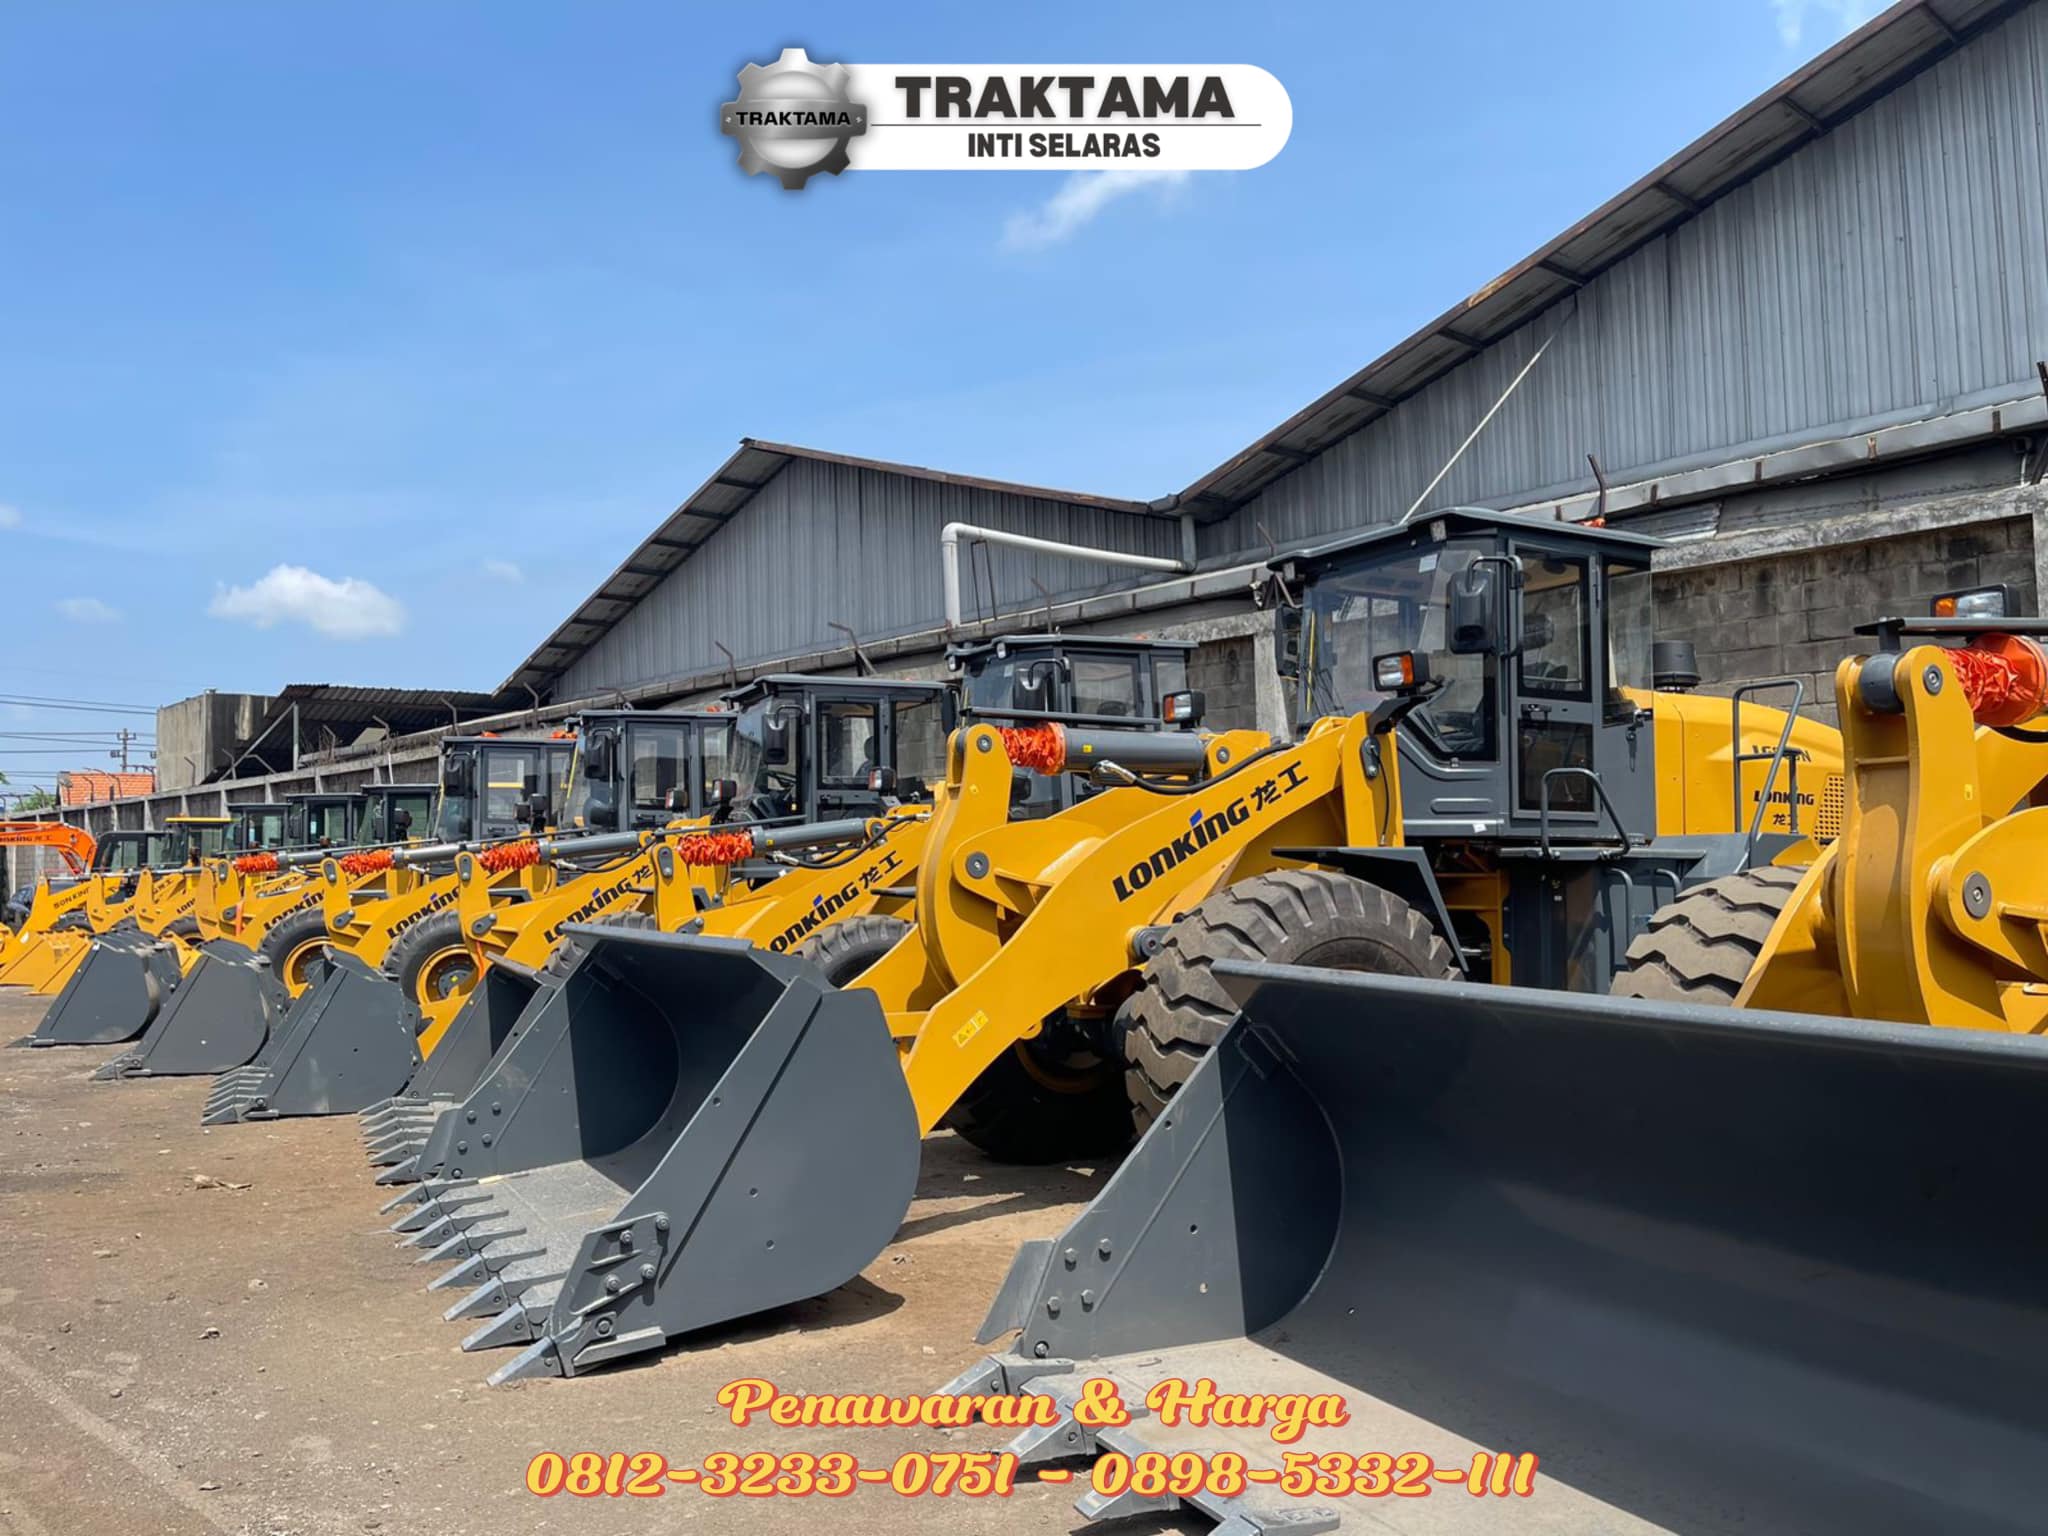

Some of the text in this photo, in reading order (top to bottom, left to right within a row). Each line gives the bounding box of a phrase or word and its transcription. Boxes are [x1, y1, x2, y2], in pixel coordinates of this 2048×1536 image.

[1250, 760, 1309, 812] 龙工
[768, 850, 904, 953] ONKING 龙工
